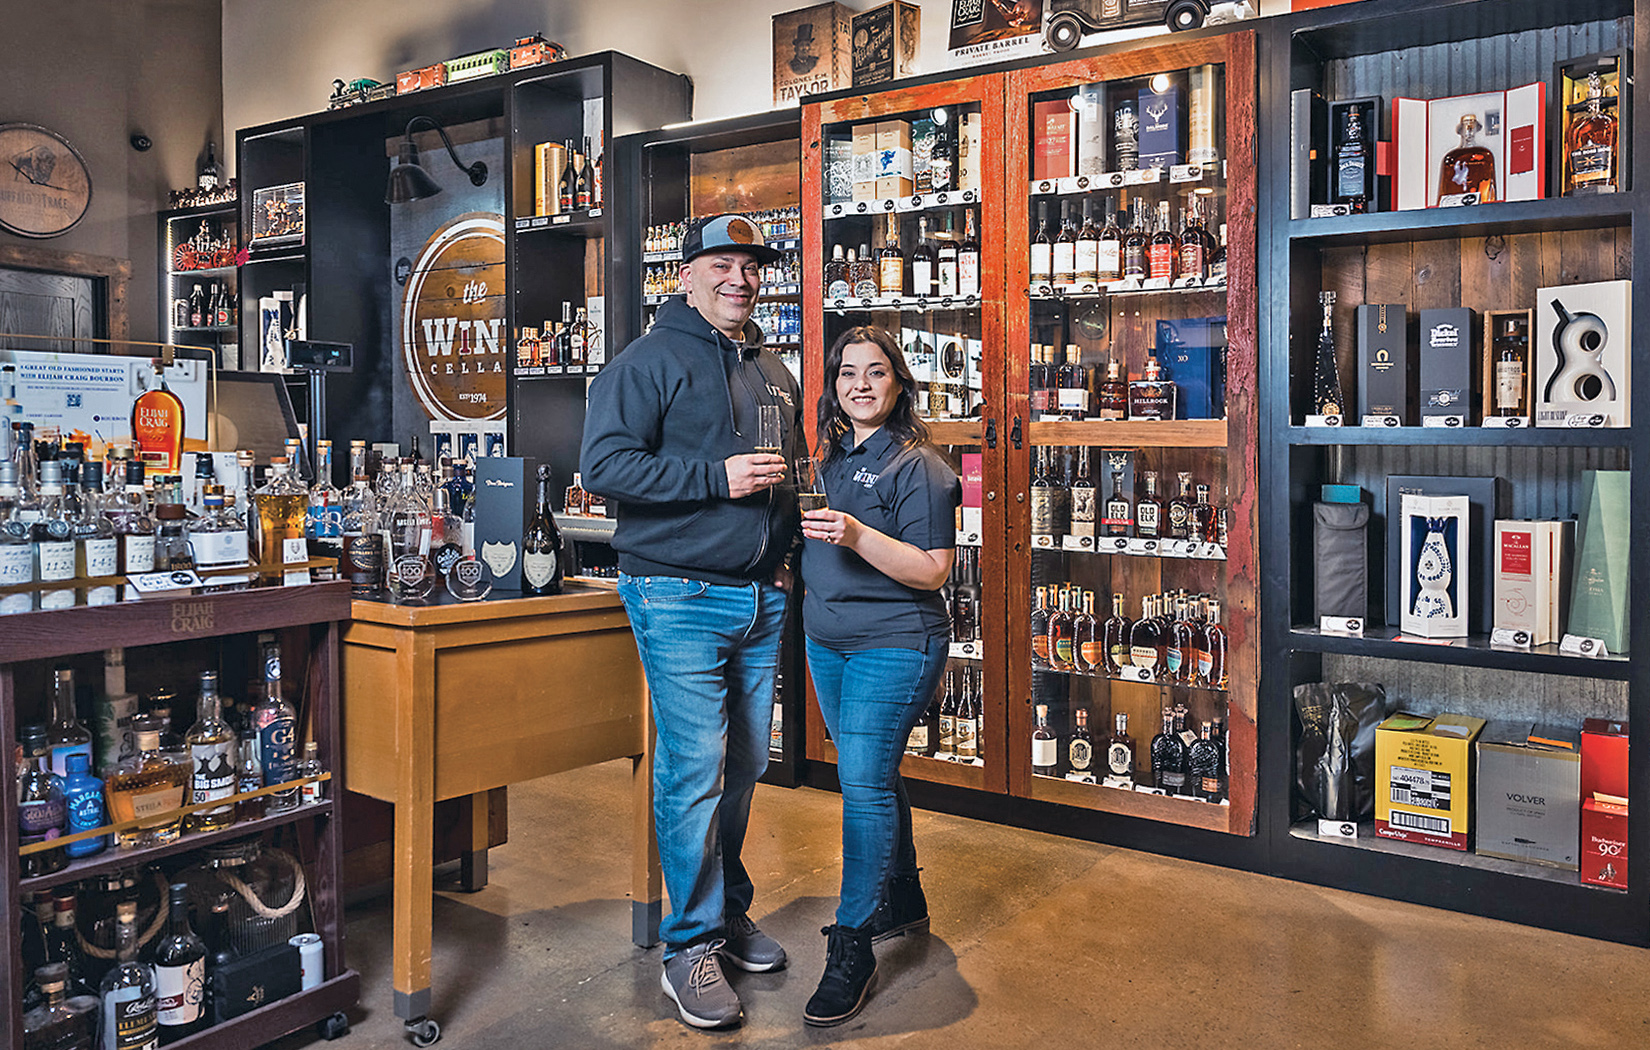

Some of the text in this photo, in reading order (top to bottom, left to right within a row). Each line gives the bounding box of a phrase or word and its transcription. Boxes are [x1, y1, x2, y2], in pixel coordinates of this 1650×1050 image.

[955, 37, 1029, 57] PRIVATE BARREL
[779, 76, 812, 86] COLONEL
[780, 80, 829, 101] TAYLOR
[42, 194, 68, 209] TRACE
[463, 280, 488, 304] the
[422, 317, 506, 357] WIN
[470, 392, 487, 403] 1974
[140, 407, 168, 418] ELIJAH
[140, 416, 168, 428] CRAIG
[852, 470, 879, 485] WIN
[1110, 504, 1126, 512] OLD
[1140, 506, 1155, 514] OLD
[1110, 512, 1126, 520] ELK
[1140, 514, 1155, 522] ELK
[172, 602, 214, 617] ELIJAH
[171, 616, 214, 633] CRAIG
[272, 727, 294, 744] G4
[194, 779, 209, 789] BIG
[195, 791, 206, 802] 50
[1506, 792, 1546, 806] VOLVER
[135, 802, 161, 813] STELLA
[1424, 837, 1461, 847] TEMPRANILLO
